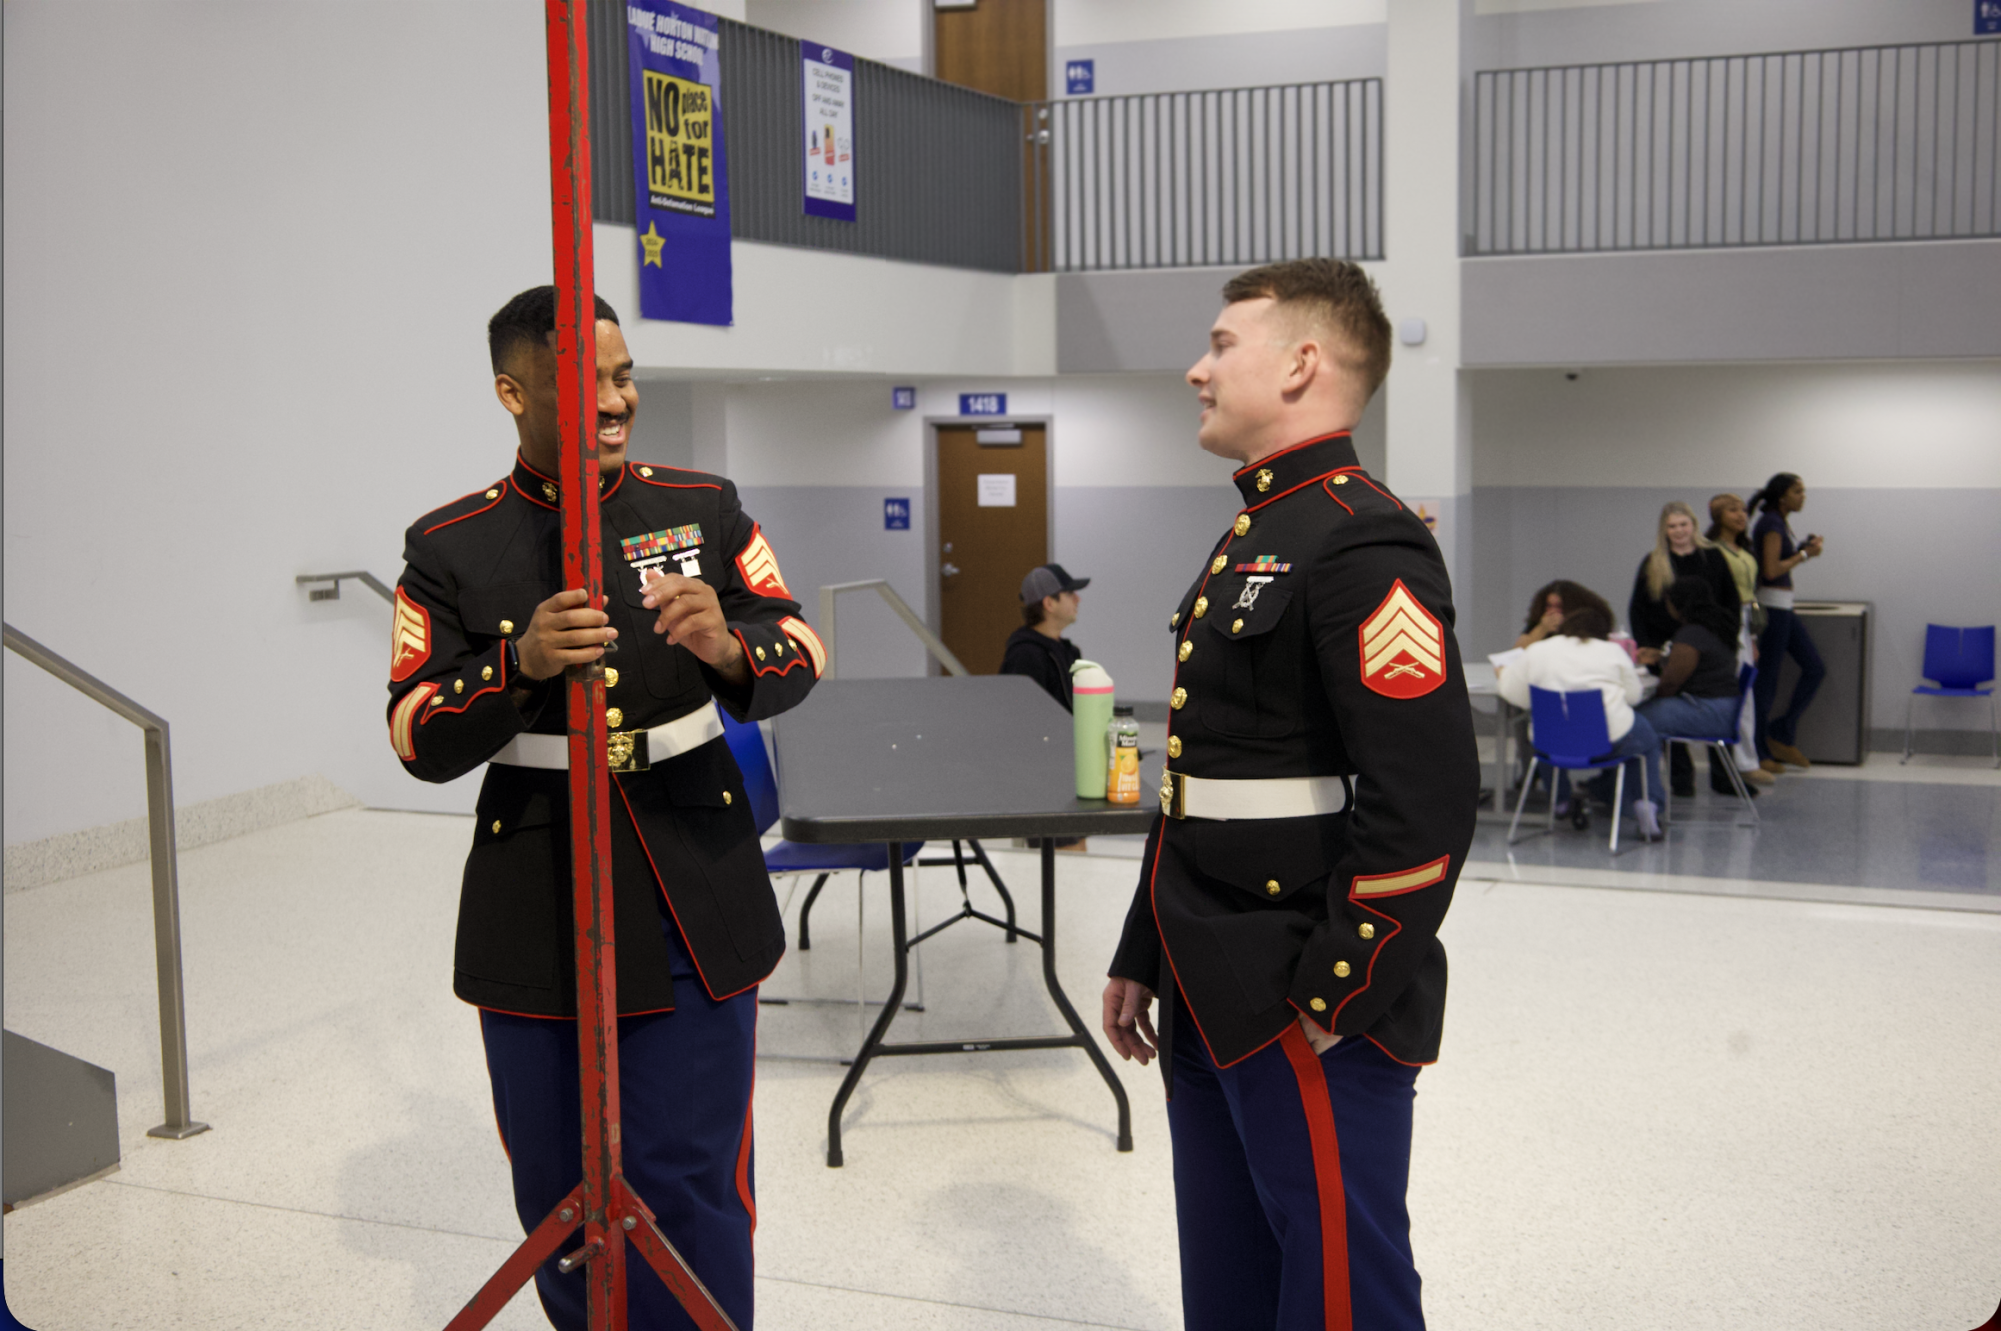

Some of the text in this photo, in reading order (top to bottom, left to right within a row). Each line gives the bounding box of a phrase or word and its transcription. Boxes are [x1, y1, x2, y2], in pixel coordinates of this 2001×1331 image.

[650, 34, 675, 57] HIGH
[647, 76, 707, 137] NO place
[684, 118, 709, 140] for
[651, 136, 710, 194] HATE
[968, 395, 998, 413] 1418
